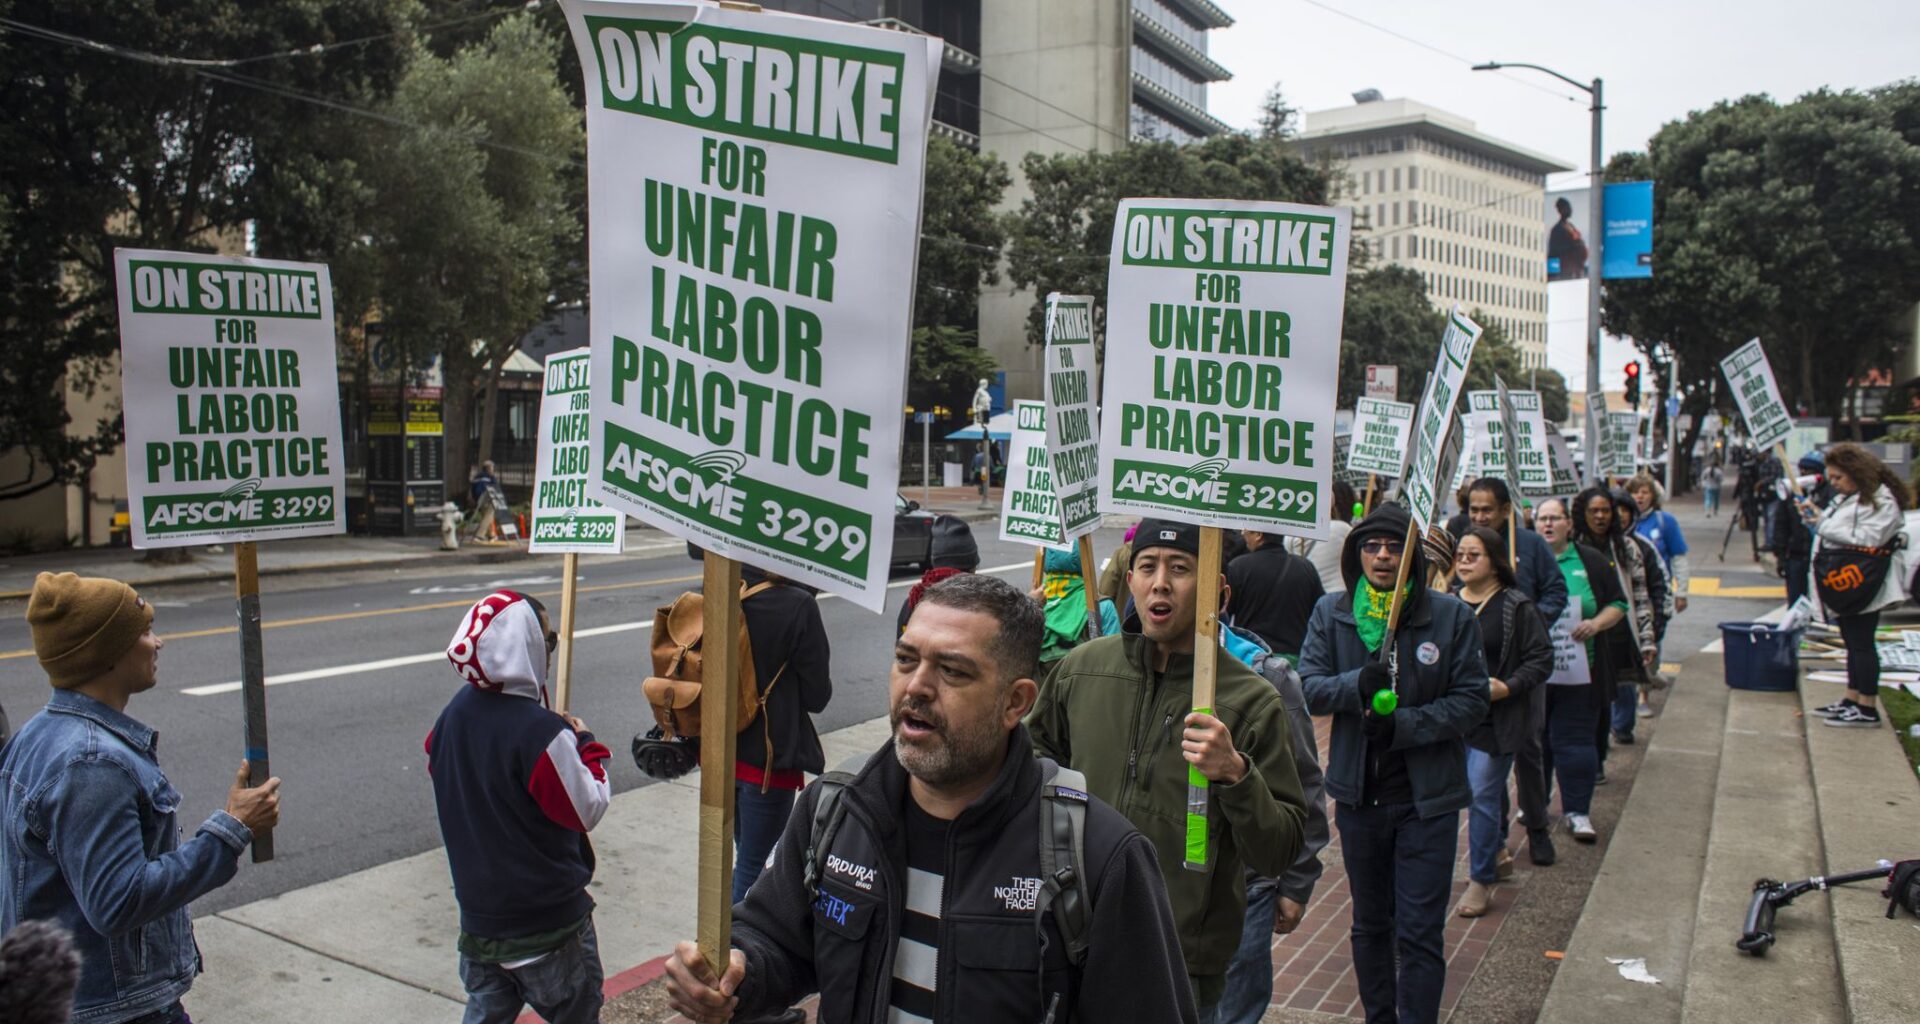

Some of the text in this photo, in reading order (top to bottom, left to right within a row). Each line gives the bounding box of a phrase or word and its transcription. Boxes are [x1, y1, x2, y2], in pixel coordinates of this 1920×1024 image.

[598, 26, 897, 151] ON STRIKE
[701, 136, 767, 197] FOR
[645, 177, 838, 303] UNFAIR
[1127, 214, 1330, 269] ON STRIKE
[134, 266, 319, 314] ON STRIKE
[1195, 272, 1241, 303] FOR
[214, 318, 257, 344] FOR
[651, 265, 823, 388] LABOR
[1053, 307, 1089, 340] STRIKE
[1149, 302, 1292, 359] UNFAIR
[168, 346, 301, 388] UNFAIR
[1059, 347, 1075, 369] FOR
[549, 363, 567, 392] ON
[1050, 369, 1088, 408] UNFAIR
[1153, 354, 1283, 412] LABOR
[177, 392, 299, 435] LABOR
[570, 392, 590, 411] FOR
[611, 335, 871, 490] PRACTICE
[1475, 395, 1493, 410] ON
[552, 413, 589, 444] UNFA
[1019, 406, 1041, 429] ON
[1056, 407, 1091, 447] LABOR
[1364, 421, 1399, 437] UNFAIR
[1120, 402, 1315, 468] PRACTICE
[1364, 434, 1395, 448] LABOR
[146, 436, 330, 483] PRACTICE
[552, 445, 589, 476] LABO
[1354, 443, 1401, 461] PRACTICE
[606, 442, 867, 562] AFSCME 3299
[1115, 469, 1230, 505] AFSCME
[1238, 484, 1315, 514] 3299
[148, 495, 332, 528] AFSCME 3299
[1065, 498, 1091, 524] AFSCME
[536, 521, 615, 539] AFSCME 3299
[1008, 520, 1049, 537] AFSCME
[826, 854, 874, 882] ORDURA
[1012, 876, 1035, 889] THE
[855, 880, 872, 890] BRAND
[994, 886, 1034, 899] NORTH
[1005, 897, 1035, 910] FACE
